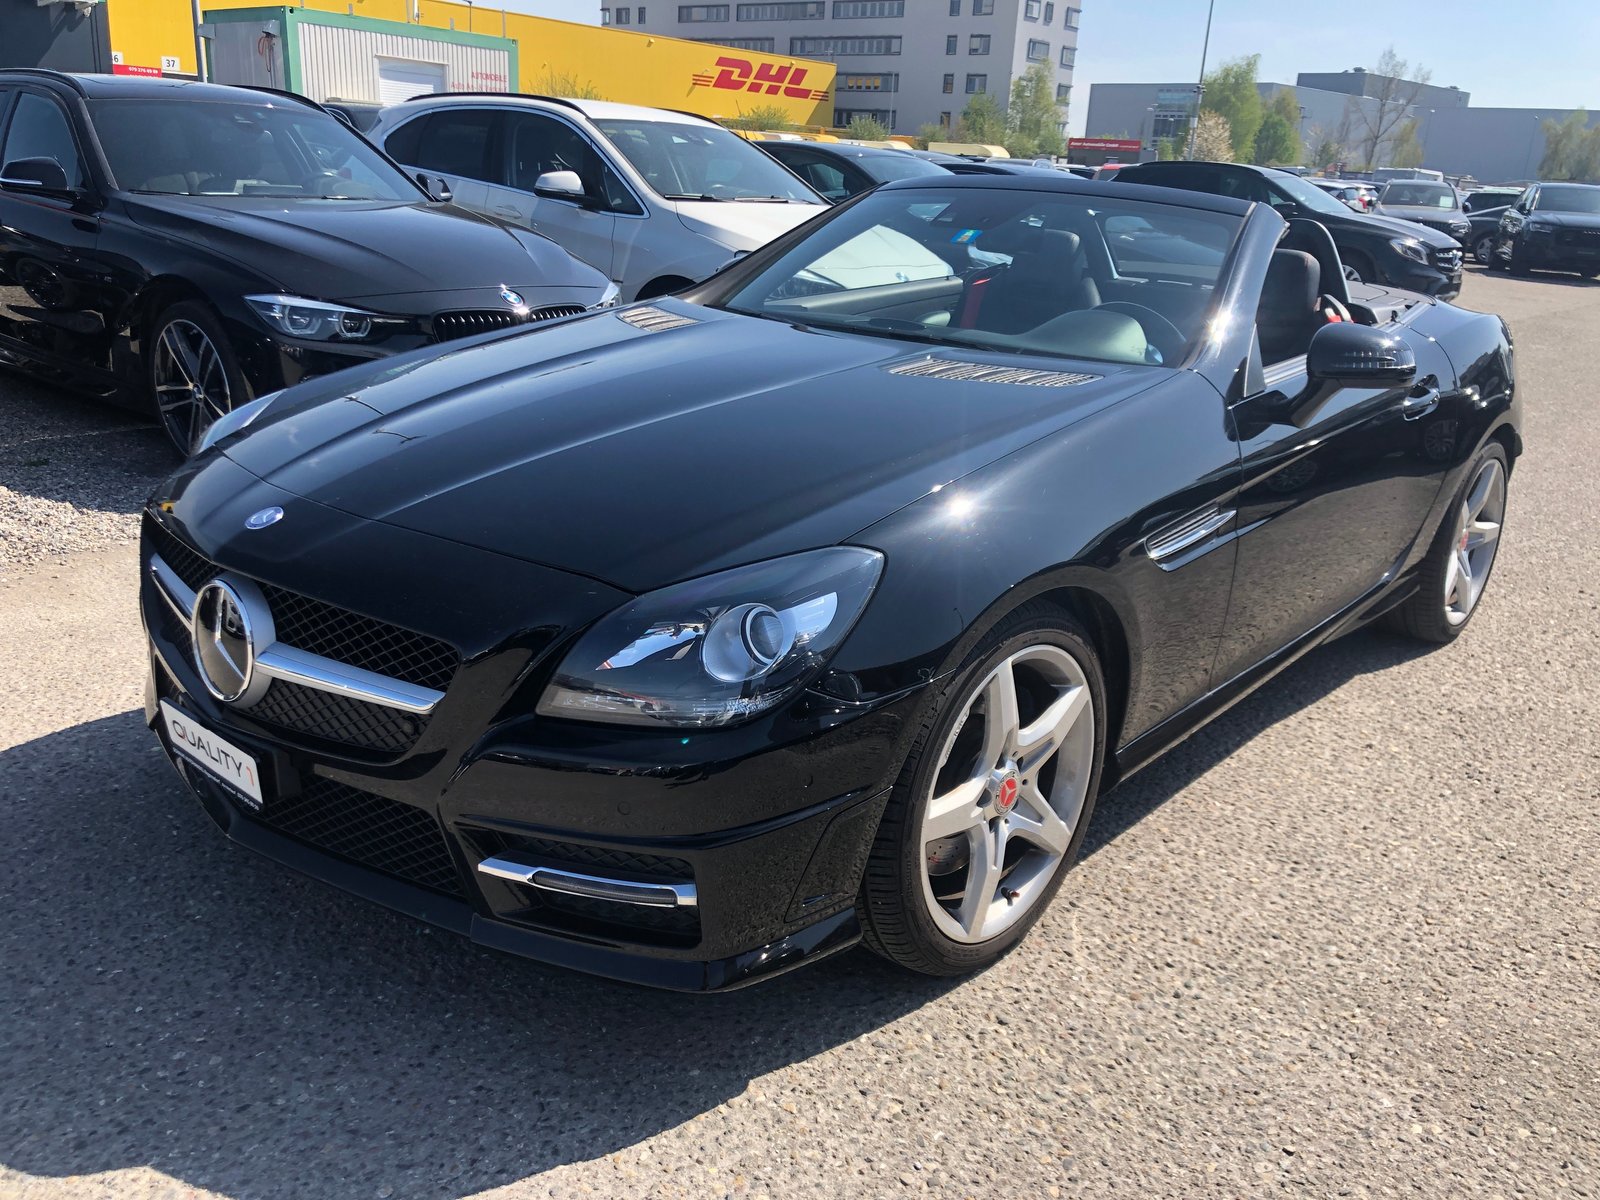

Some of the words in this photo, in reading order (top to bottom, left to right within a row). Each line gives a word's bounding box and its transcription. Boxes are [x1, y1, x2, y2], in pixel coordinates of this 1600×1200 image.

[112, 55, 119, 63] 6
[166, 59, 176, 68] 37
[471, 72, 508, 82] AUTOMOBILE
[712, 56, 813, 99] DHL
[172, 720, 242, 777] QUALITY
